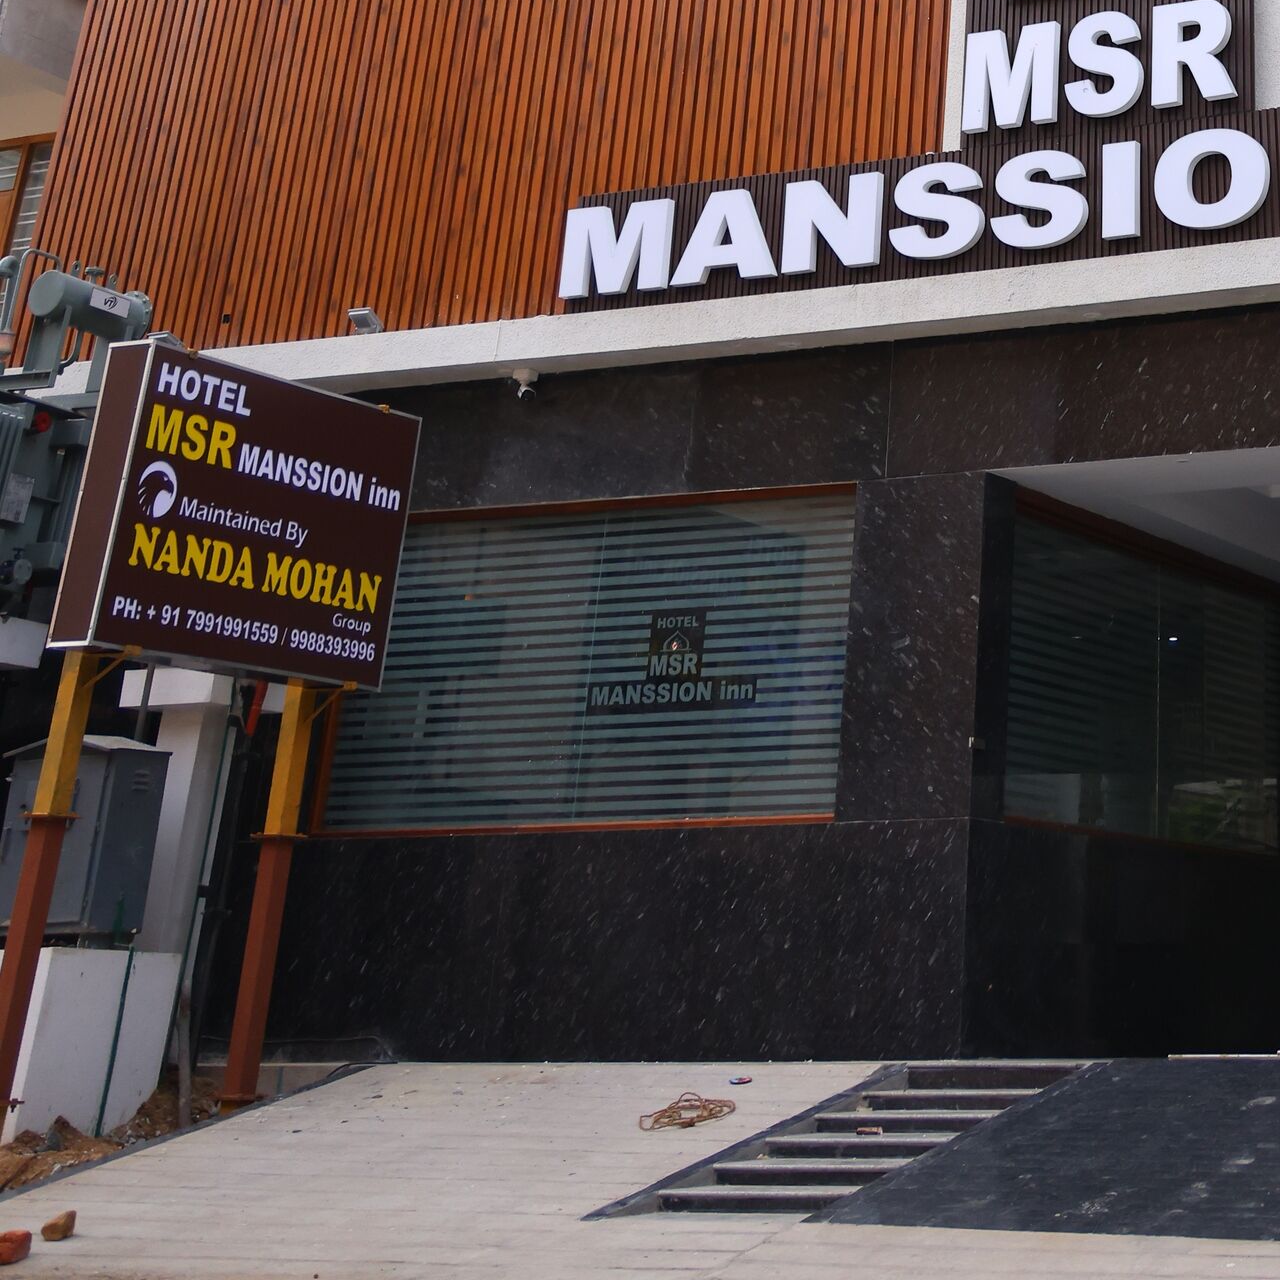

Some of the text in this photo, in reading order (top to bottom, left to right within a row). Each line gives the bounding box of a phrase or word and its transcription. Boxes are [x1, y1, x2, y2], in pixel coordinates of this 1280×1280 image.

[157, 362, 251, 417] HOTEL
[145, 403, 401, 511] MSR MANSSION inn
[179, 496, 308, 548] Maintained By
[128, 522, 382, 614] NANDA MOHAN
[112, 595, 142, 620] PH:
[161, 604, 180, 627] 91
[186, 609, 279, 644] 7991991559
[290, 629, 375, 662] 9988393996
[332, 612, 371, 636] Group
[657, 616, 699, 629] HOTEL
[650, 653, 698, 677] MSR
[591, 680, 753, 706] MANSSION inn
